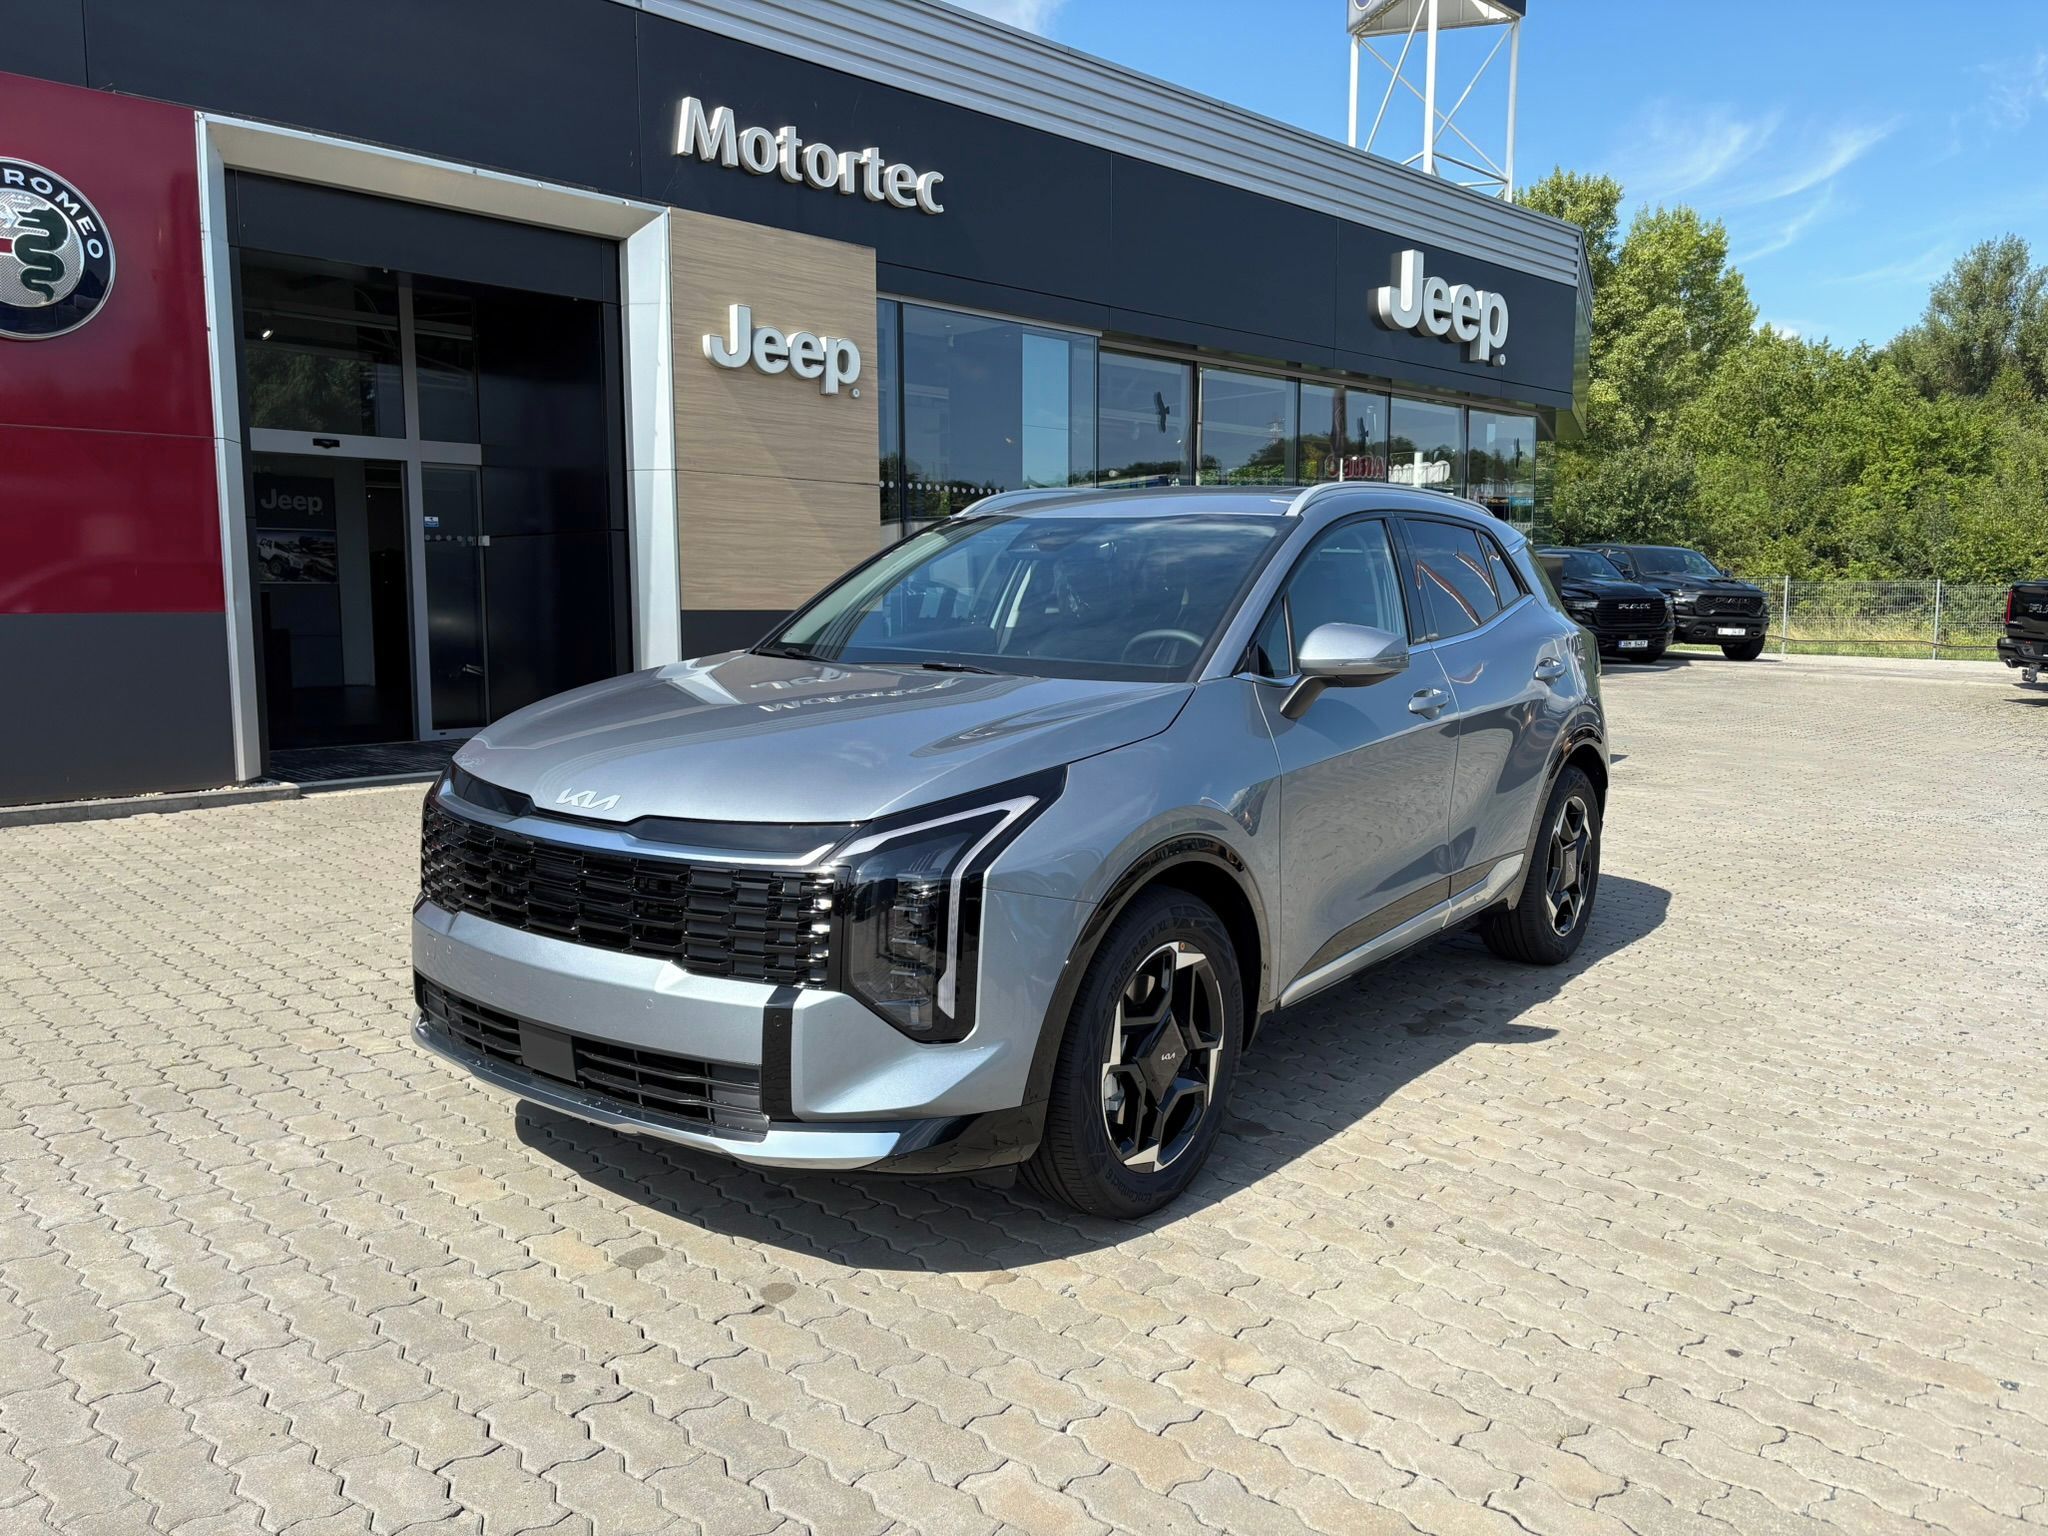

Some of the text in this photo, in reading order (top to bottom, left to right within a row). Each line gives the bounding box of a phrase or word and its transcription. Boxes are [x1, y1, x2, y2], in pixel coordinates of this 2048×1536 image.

[677, 96, 945, 215] Motortec
[3, 167, 104, 260] ROMEO
[702, 303, 861, 396] Jeep
[1378, 249, 1509, 362] Jeep
[260, 488, 323, 515] Jeep
[555, 787, 622, 812] KIA
